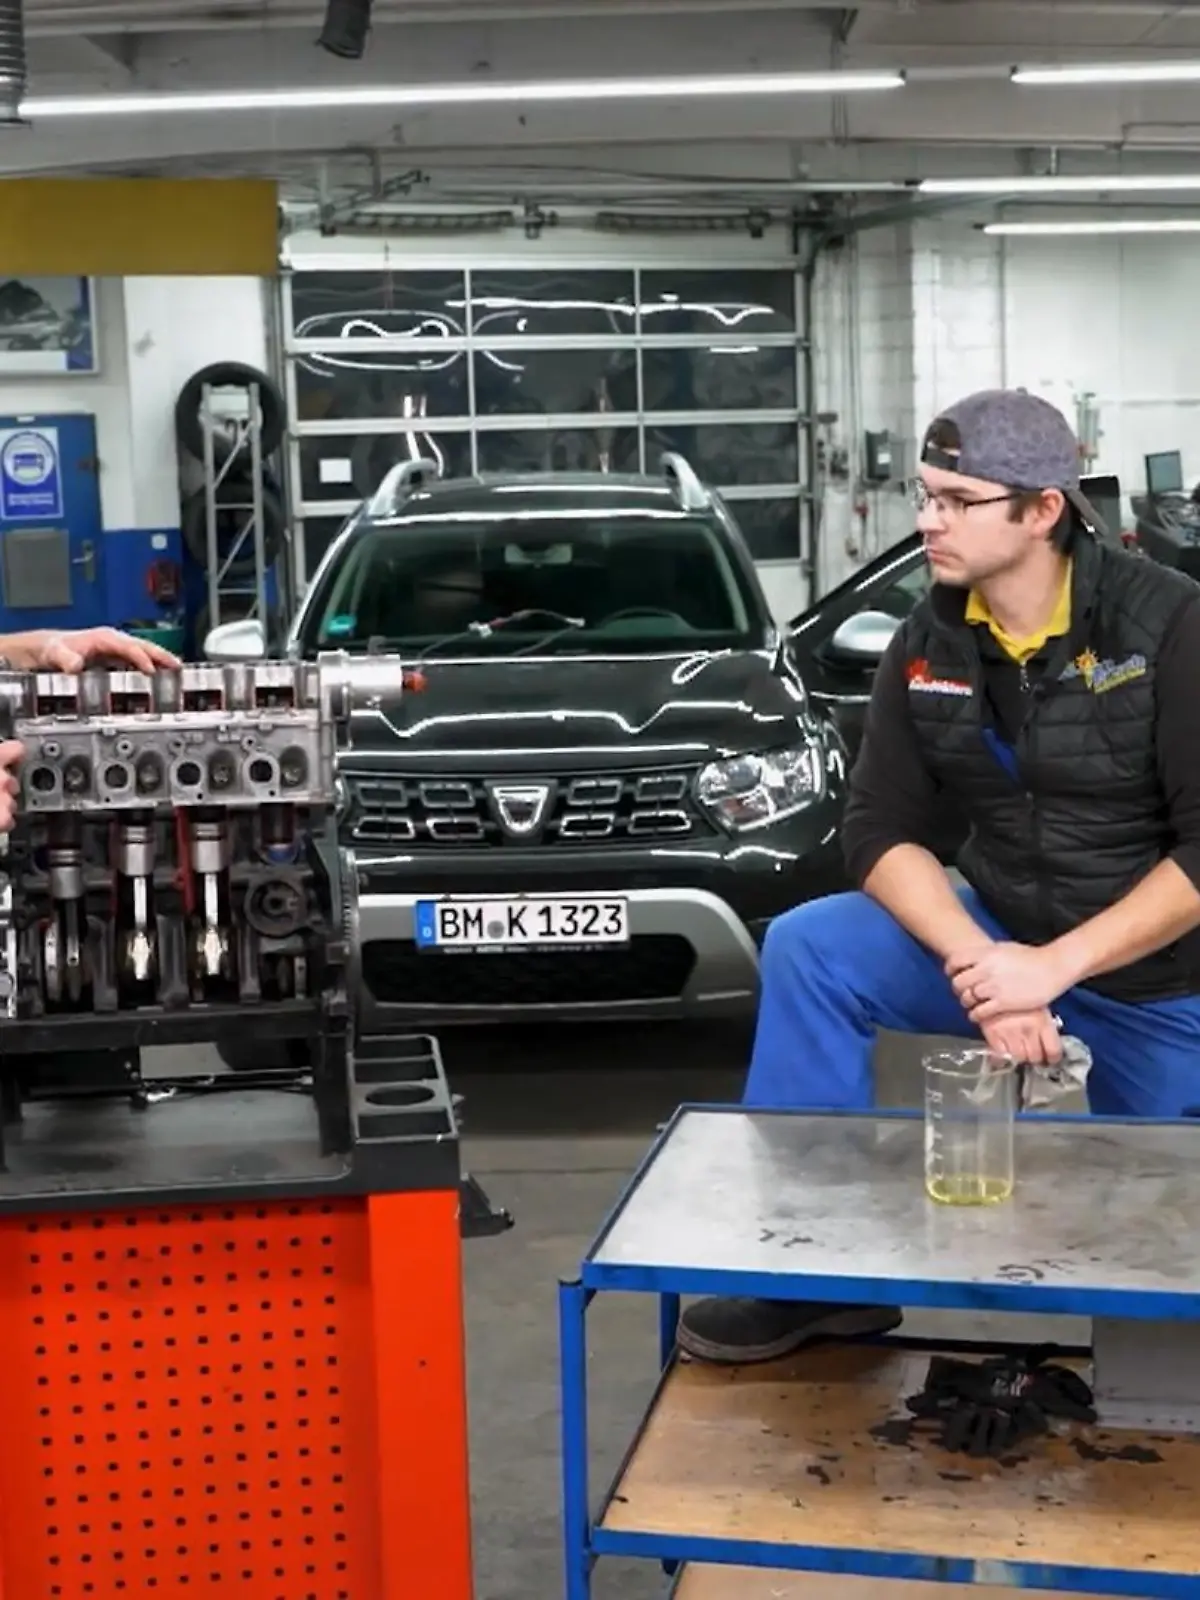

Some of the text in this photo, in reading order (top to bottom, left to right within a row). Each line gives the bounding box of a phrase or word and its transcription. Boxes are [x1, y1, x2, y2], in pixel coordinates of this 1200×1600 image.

[439, 904, 622, 939] BM K 1323
